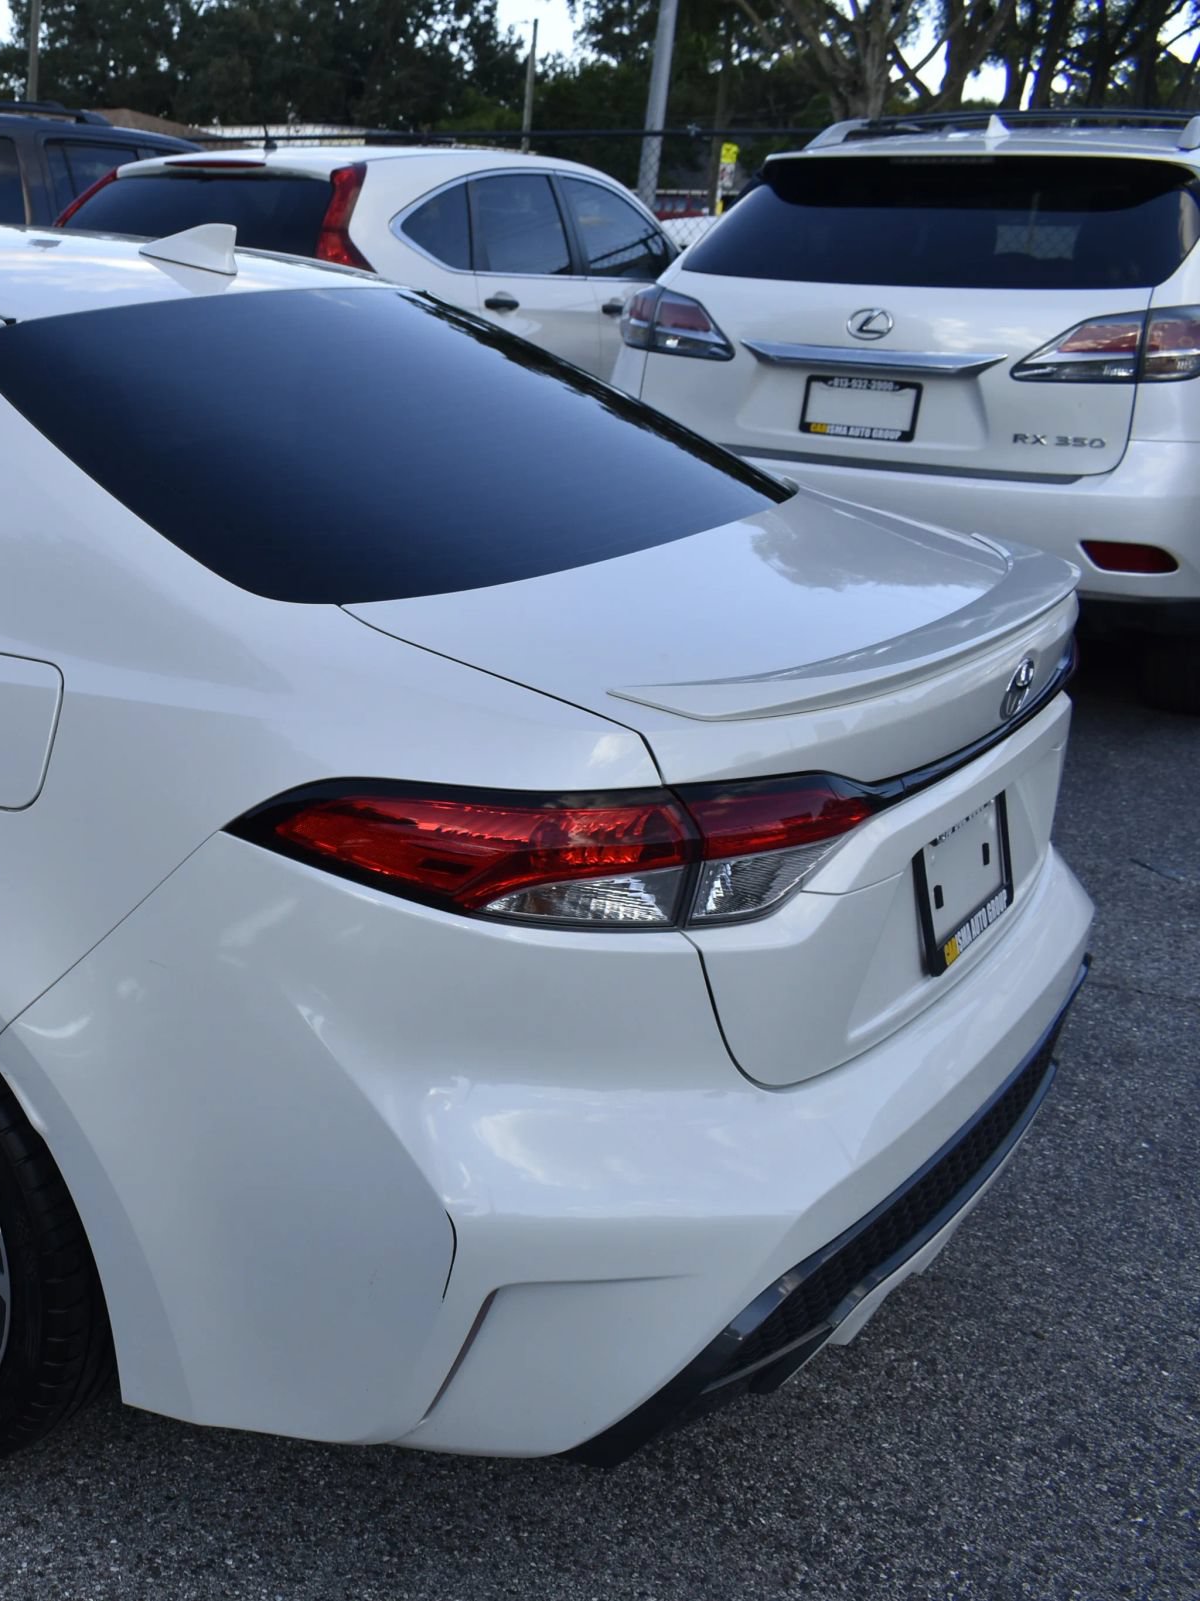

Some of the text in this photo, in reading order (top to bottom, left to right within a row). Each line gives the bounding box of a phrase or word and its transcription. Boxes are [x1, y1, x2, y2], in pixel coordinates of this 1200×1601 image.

[848, 425, 872, 437] AUTO
[871, 427, 902, 440] GROUP
[1012, 433, 1106, 449] RX 350
[970, 907, 988, 937] AUTO
[986, 888, 1008, 924] GROUP
